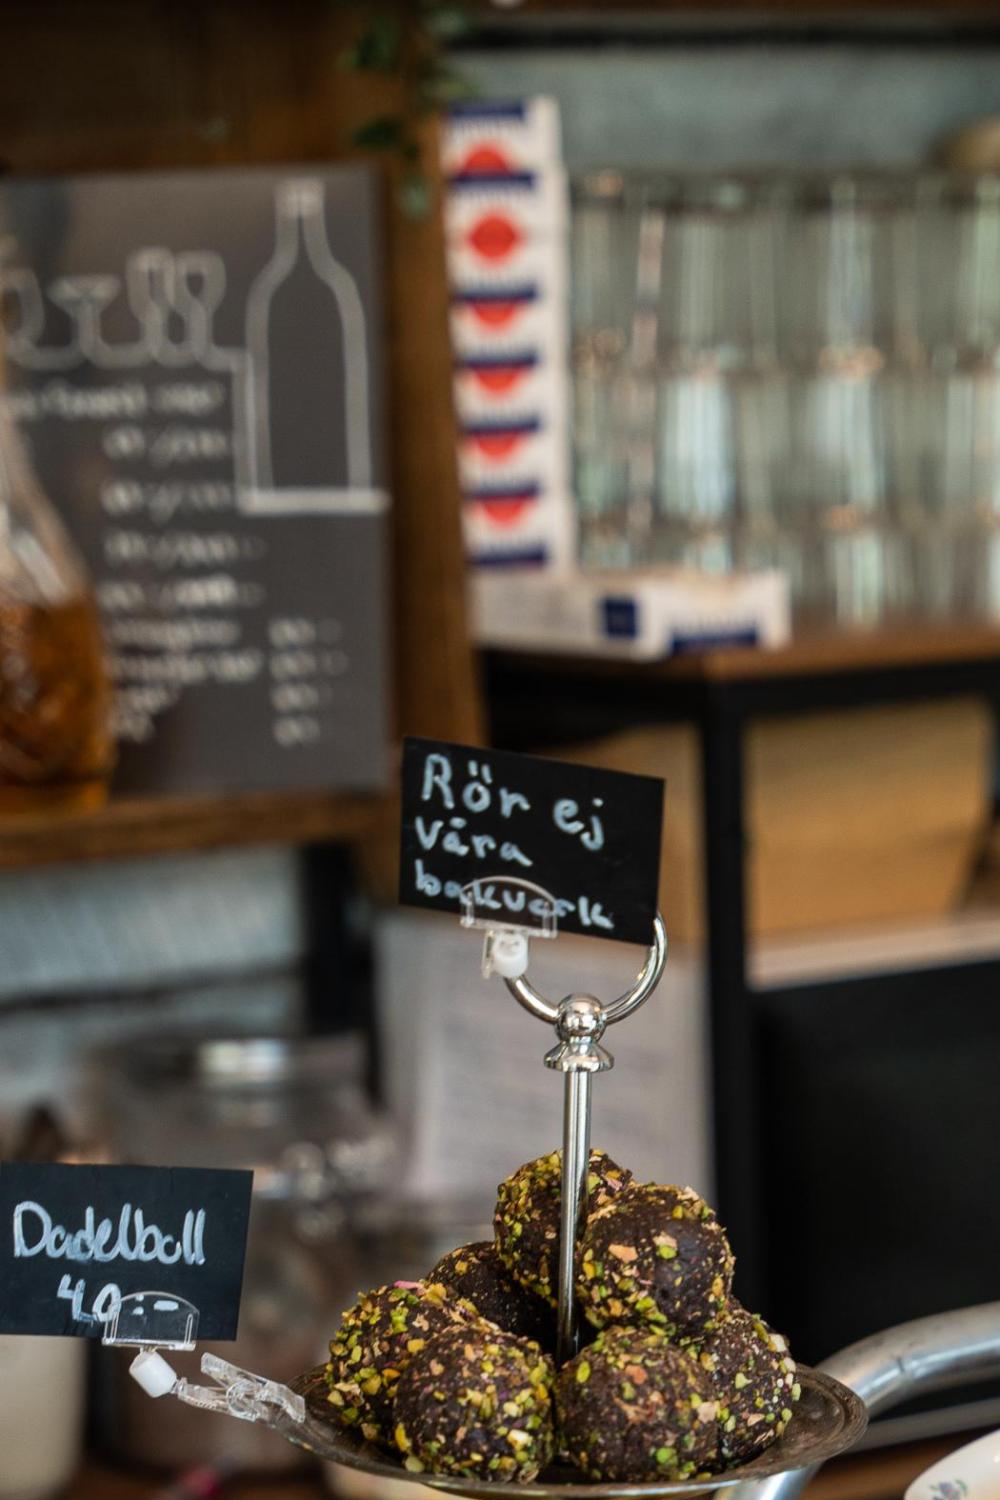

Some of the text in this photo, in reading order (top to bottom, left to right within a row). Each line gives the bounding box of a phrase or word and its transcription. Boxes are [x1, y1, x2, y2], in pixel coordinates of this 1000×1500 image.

[421, 753, 605, 852] Rör ej
[13, 1200, 206, 1266] Dadelball
